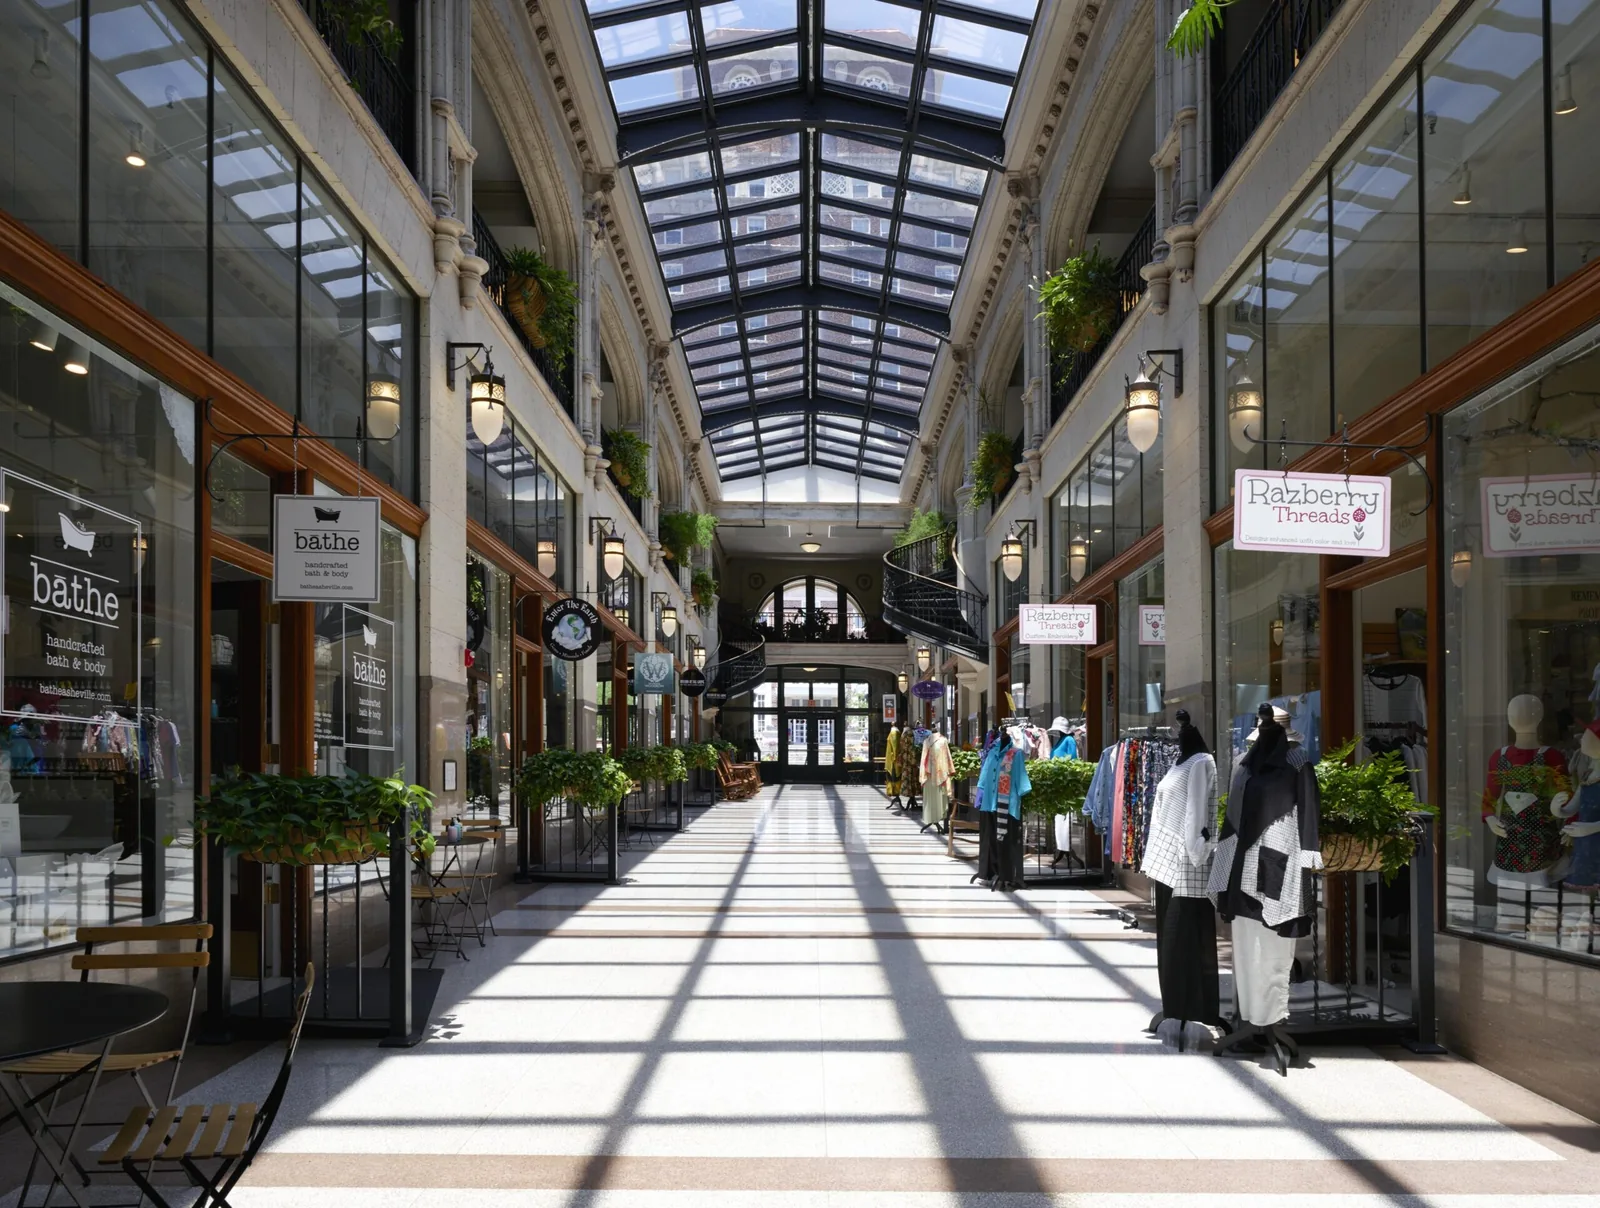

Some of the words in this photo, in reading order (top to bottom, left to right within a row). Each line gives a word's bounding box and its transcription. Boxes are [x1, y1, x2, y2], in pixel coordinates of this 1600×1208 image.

[1248, 479, 1379, 514] Razberry
[1273, 506, 1350, 524] Threads
[294, 532, 359, 551] bāthe
[1245, 535, 1269, 543] Designs
[30, 562, 119, 620] bāthe
[546, 605, 564, 623] Enter
[565, 600, 580, 609] The
[581, 604, 598, 624] Earth
[1026, 609, 1090, 624] Razberry
[1039, 621, 1077, 629] Threads
[47, 634, 105, 656] handcrafted
[47, 653, 69, 668] bath
[73, 658, 82, 670] &
[84, 659, 106, 676] body
[40, 684, 112, 702] batheasheville.com
